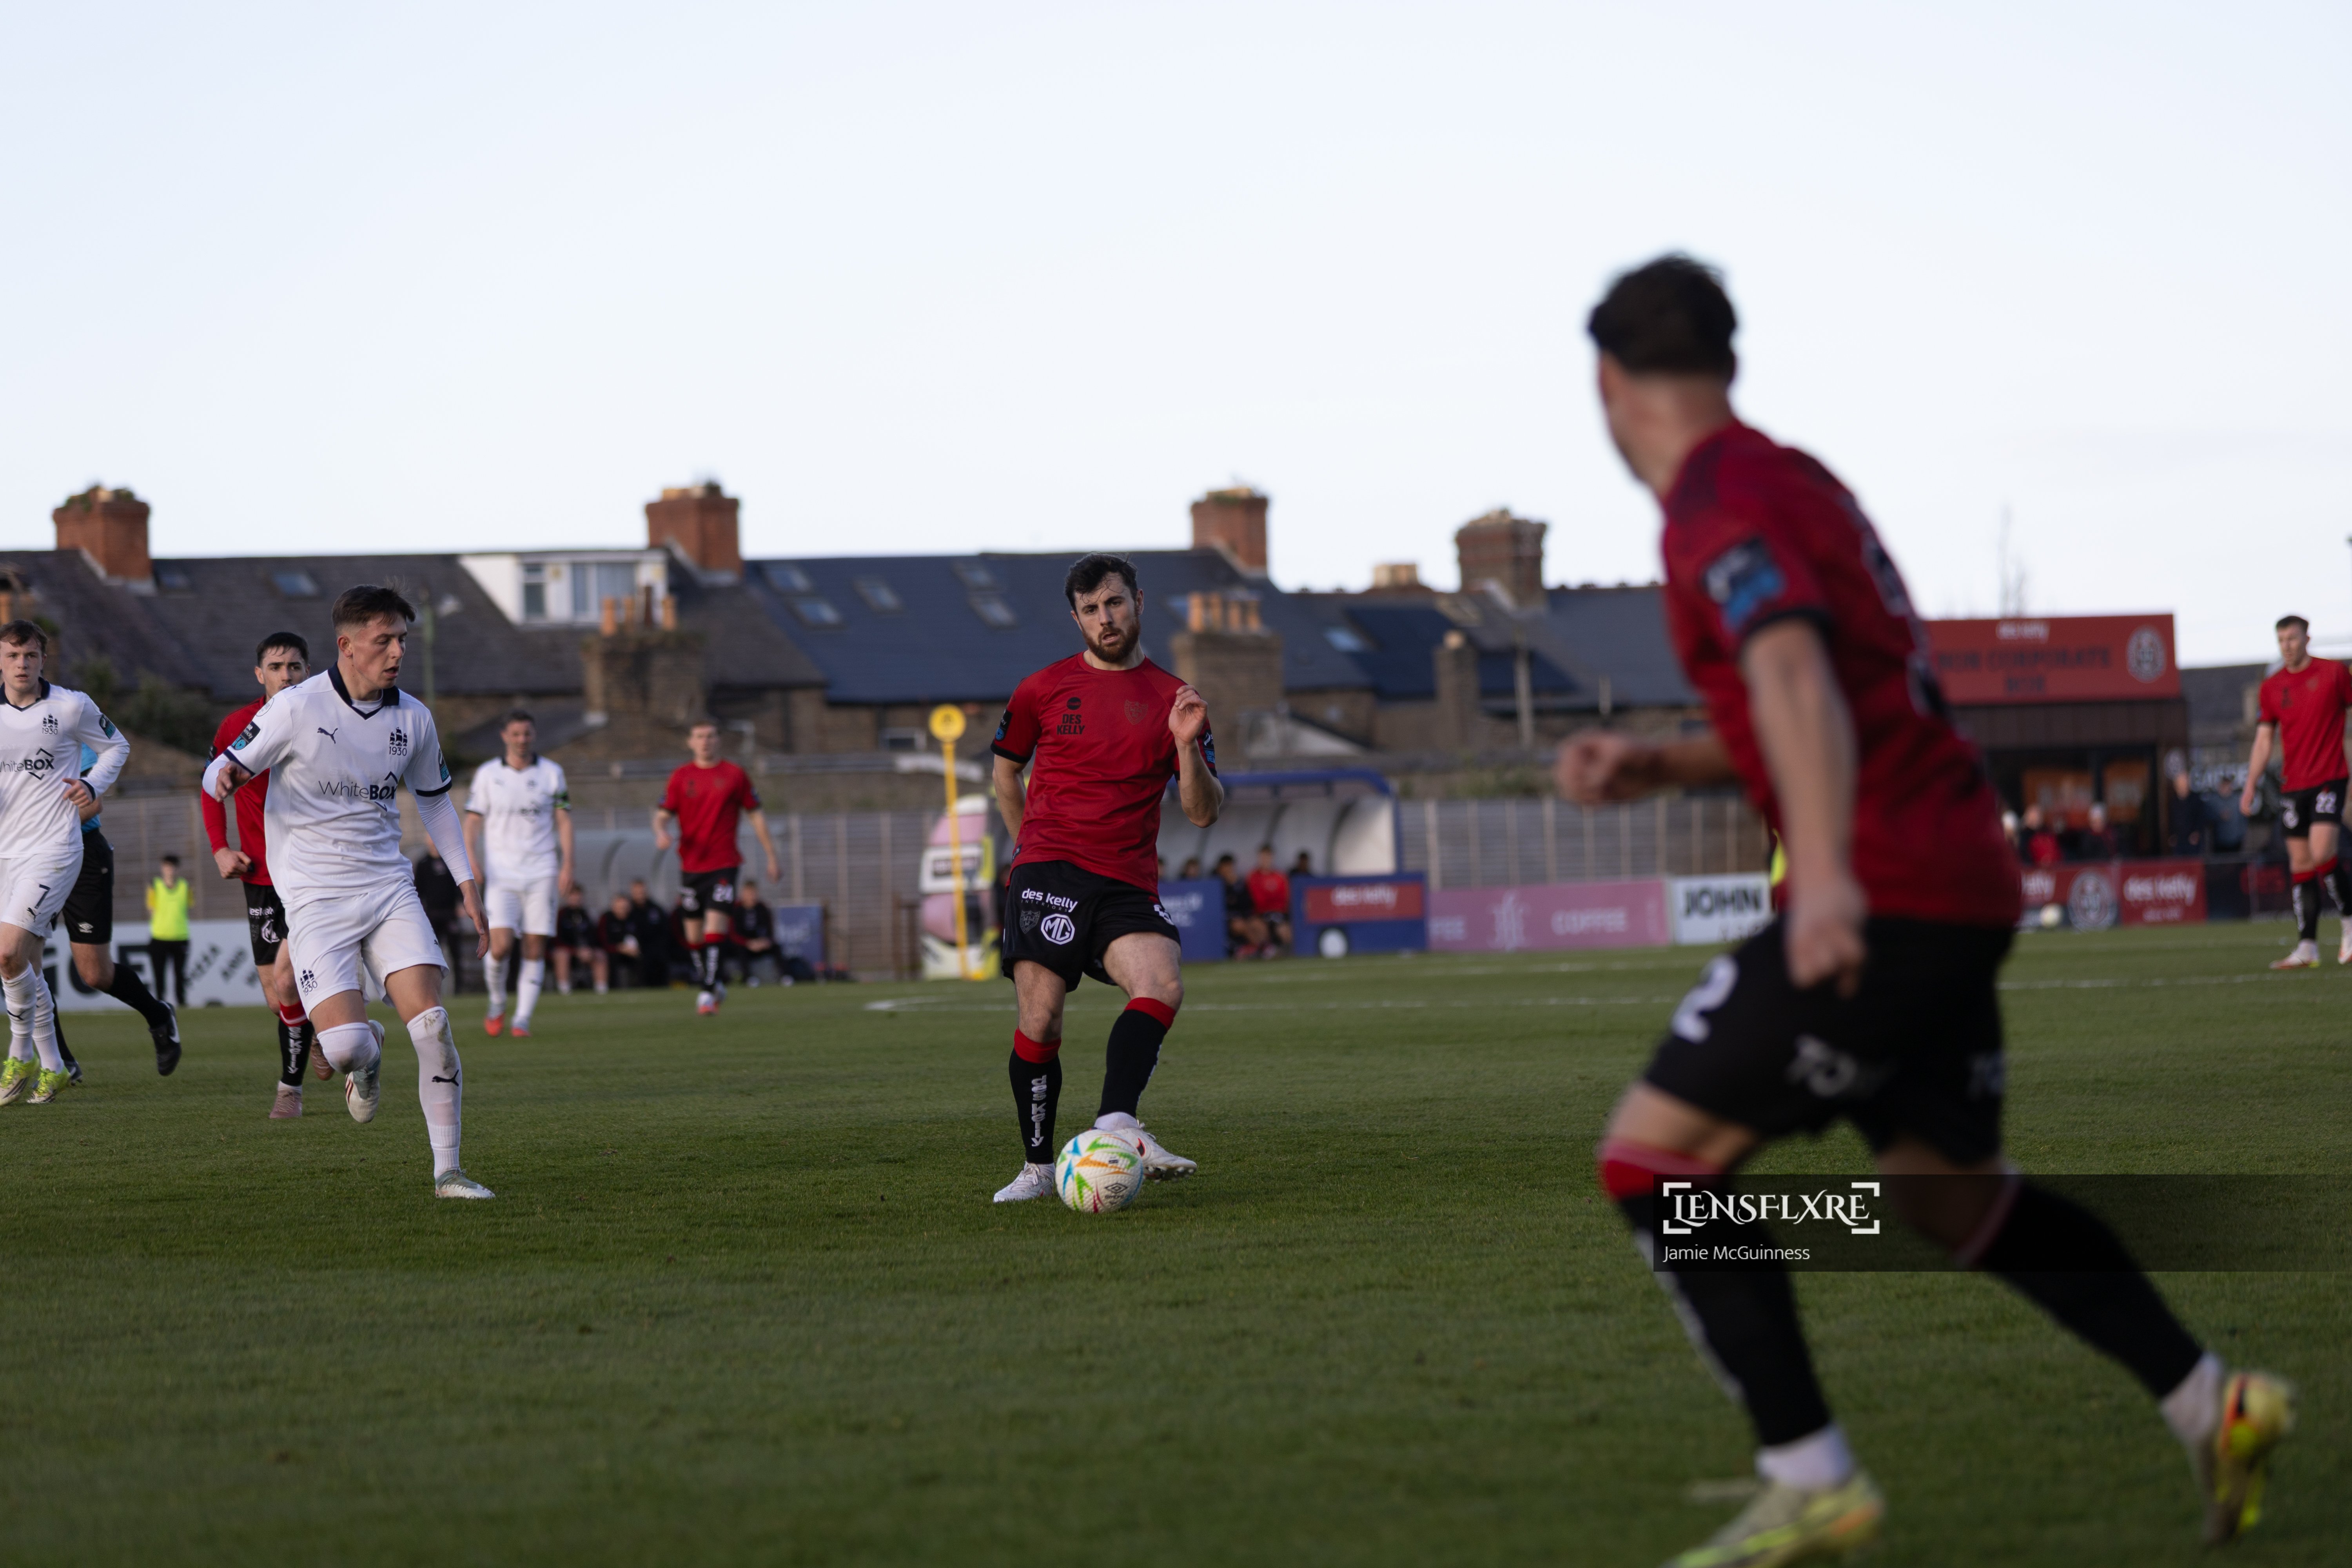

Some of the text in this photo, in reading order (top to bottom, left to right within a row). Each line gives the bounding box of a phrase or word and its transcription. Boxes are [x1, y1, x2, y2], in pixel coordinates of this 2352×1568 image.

[1062, 714, 1082, 724] DES
[1056, 724, 1085, 735] KELLY
[389, 746, 407, 756] 1930
[0, 758, 54, 773] hiteBOX
[318, 780, 397, 800] WhiteBOX
[2315, 791, 2337, 814] 22
[34, 884, 51, 909] 7
[1022, 888, 1078, 913] des kelly
[1683, 887, 1762, 918] JOHN
[1021, 900, 1067, 912] INTERIORS
[1044, 917, 1071, 941] MG
[303, 980, 318, 997] 1930
